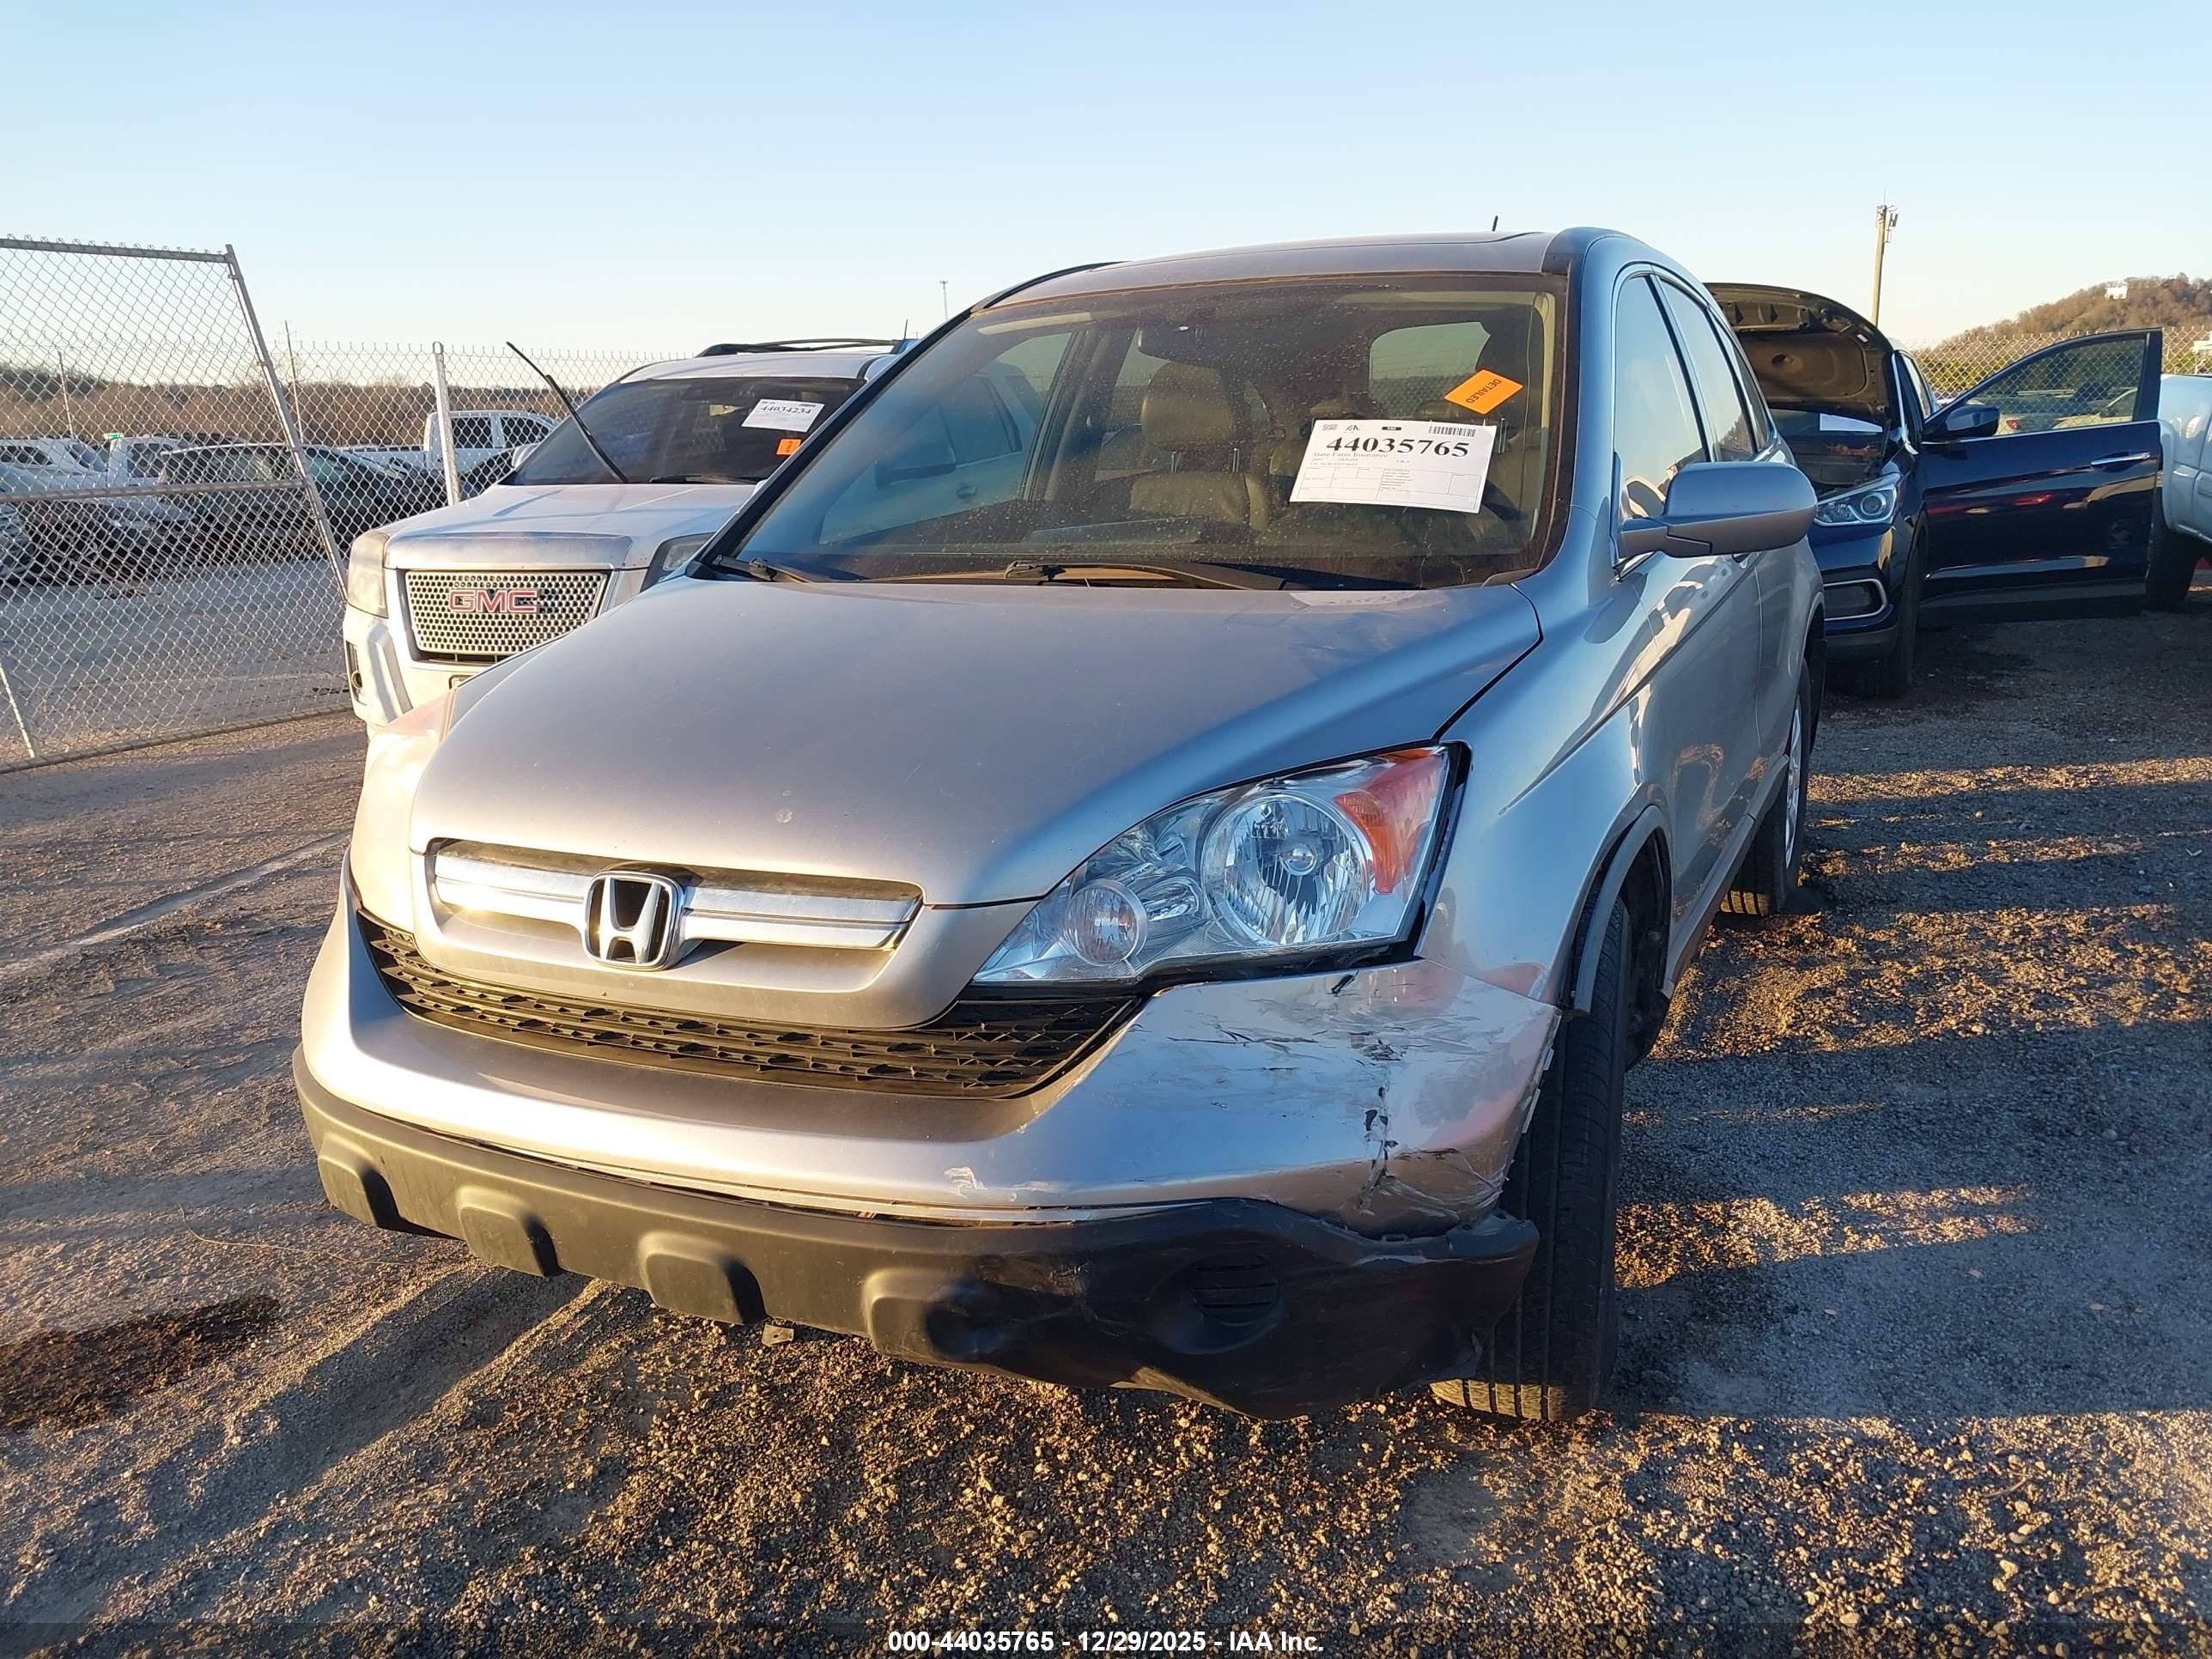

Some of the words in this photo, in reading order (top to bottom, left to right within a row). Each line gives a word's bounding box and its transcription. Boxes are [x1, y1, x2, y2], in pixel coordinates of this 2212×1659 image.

[1466, 379, 1502, 403] DETAILED
[1326, 436, 1470, 458] 44035765
[449, 589, 538, 613] GMC
